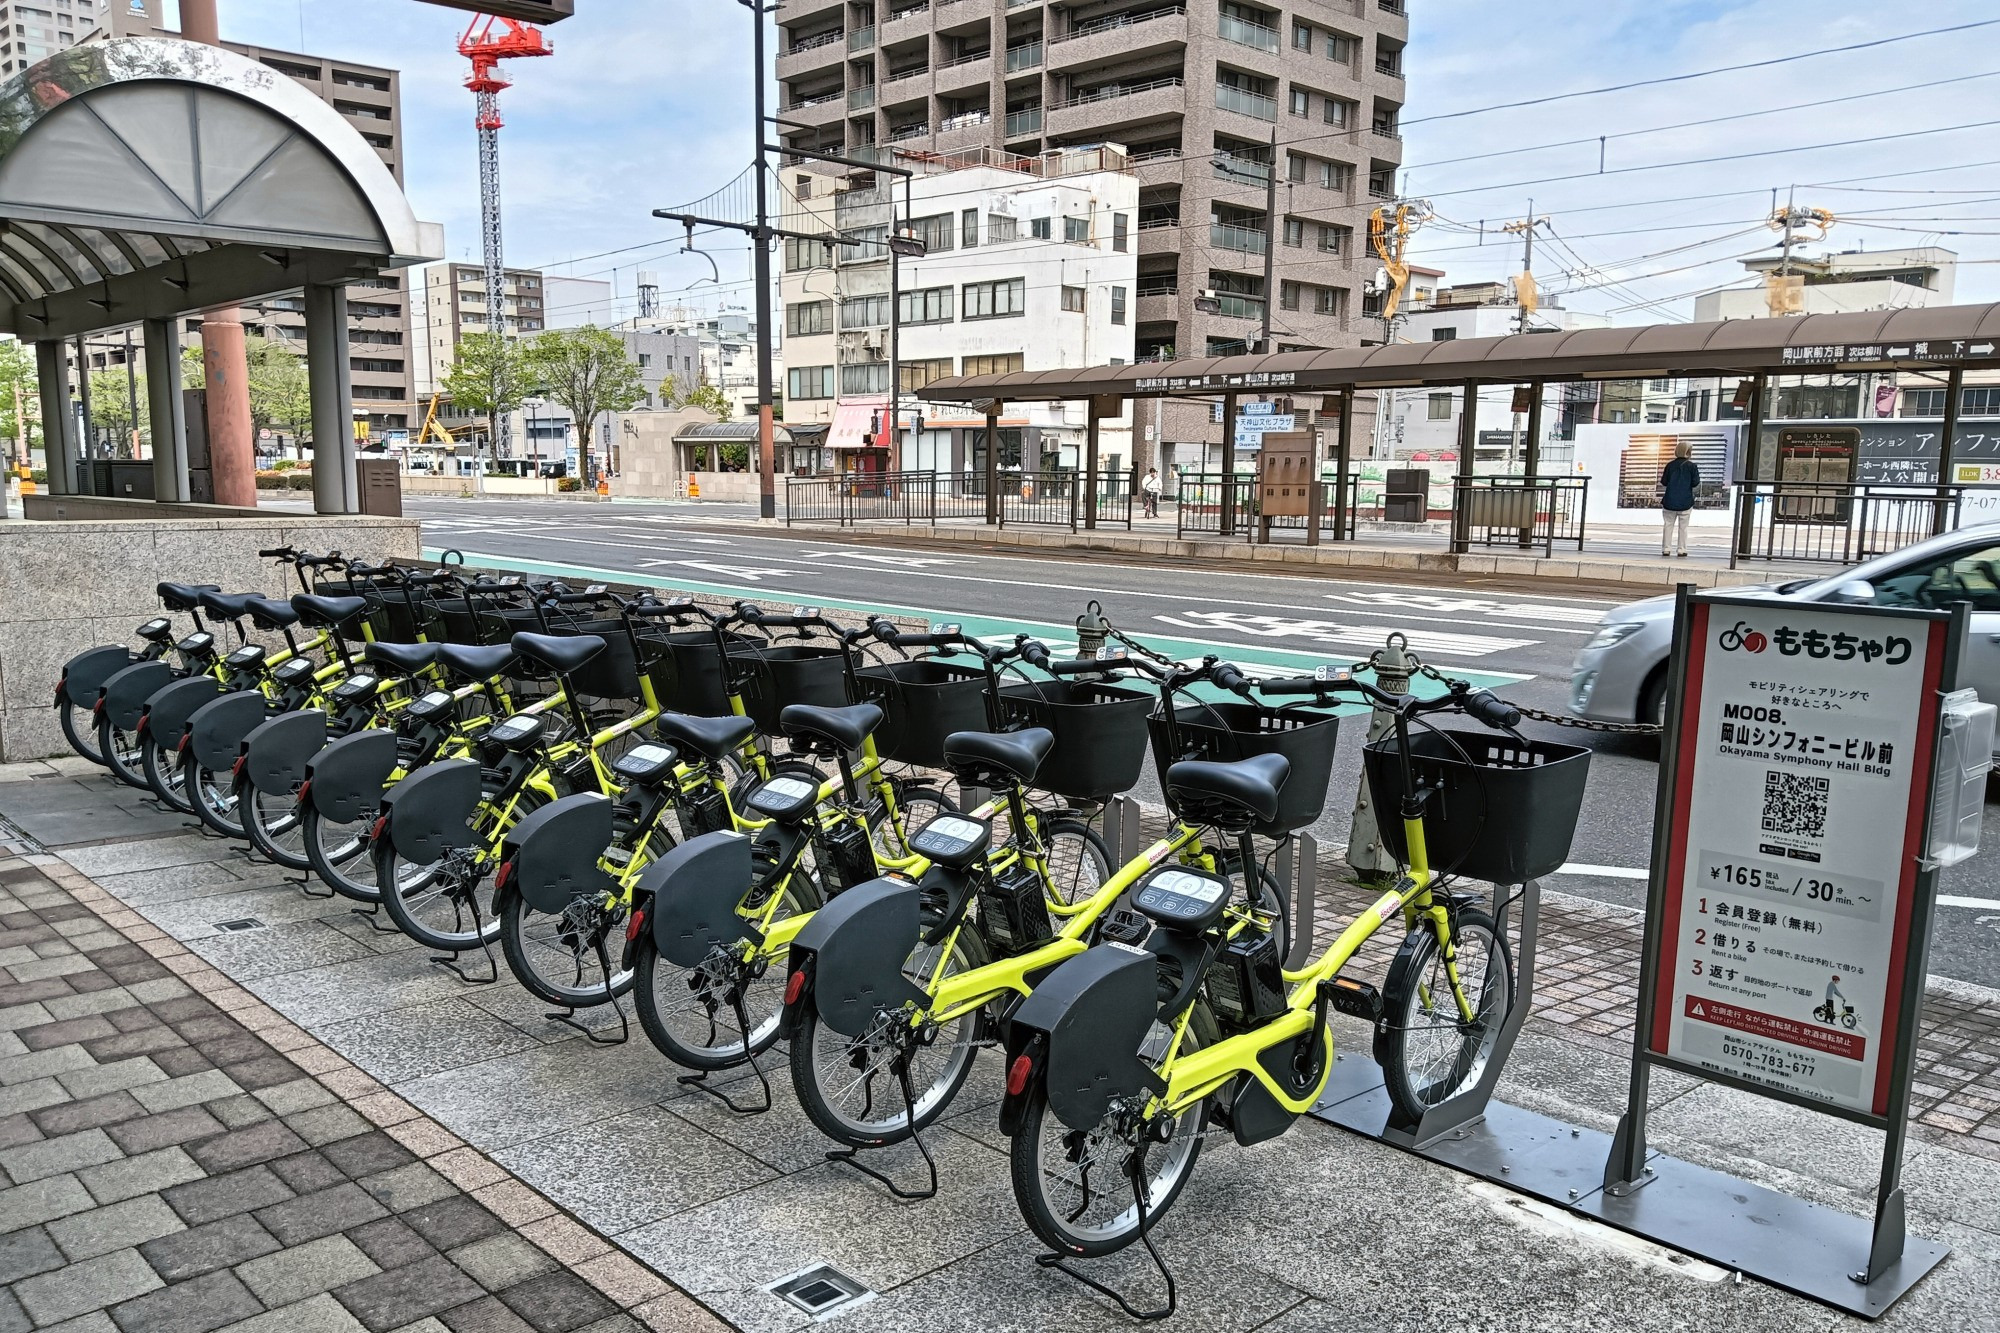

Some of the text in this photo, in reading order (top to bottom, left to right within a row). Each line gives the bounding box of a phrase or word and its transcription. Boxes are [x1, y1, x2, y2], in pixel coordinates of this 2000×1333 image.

[1783, 346, 1845, 359] 岡山駅前方面
[1849, 346, 1882, 357] 次は柳川
[1240, 418, 1292, 426] 天神山文化プラザ
[1773, 626, 1912, 665] ももちゃり
[1748, 681, 1870, 701] モビリティシェアリングで
[1771, 695, 1842, 711] 好きなところへ
[1720, 722, 1894, 765] 岡山シンフォニービル前
[1719, 744, 1891, 777] Okayama Symphony Hall Bldg
[977, 807, 994, 819] ocomo
[1148, 846, 1169, 863] docomo
[1765, 871, 1780, 880] 税込
[1764, 885, 1789, 894] included
[1807, 879, 1834, 902] 30
[1380, 899, 1400, 919] docomo
[1699, 897, 1708, 914] 1
[1835, 896, 1854, 906] min.
[1714, 917, 1761, 933] Register (Free)
[1694, 928, 1756, 953] 2 借りる
[1711, 948, 1726, 959] Rent
[1732, 952, 1748, 962] bike
[1762, 946, 1865, 975] その場で、または予約して借りる
[1691, 959, 1739, 982] 3 返す
[1708, 980, 1730, 991] Return
[1738, 987, 1751, 998] any
[1751, 990, 1767, 999] port
[1744, 975, 1813, 997] 目的地のポートで返却
[1710, 1014, 1723, 1022] KEEP
[1744, 1022, 1777, 1036] DISTRACTED
[1808, 1038, 1828, 1048] DRUNK
[1828, 1042, 1851, 1054] DRIVING
[1711, 1005, 1852, 1047] 左側走行 ながら運転禁止 飲酒運転禁止
[1724, 1034, 1816, 1064] 岡山市シェアサイクル ももちゃり
[1723, 1044, 1815, 1077] 0570-783-677
